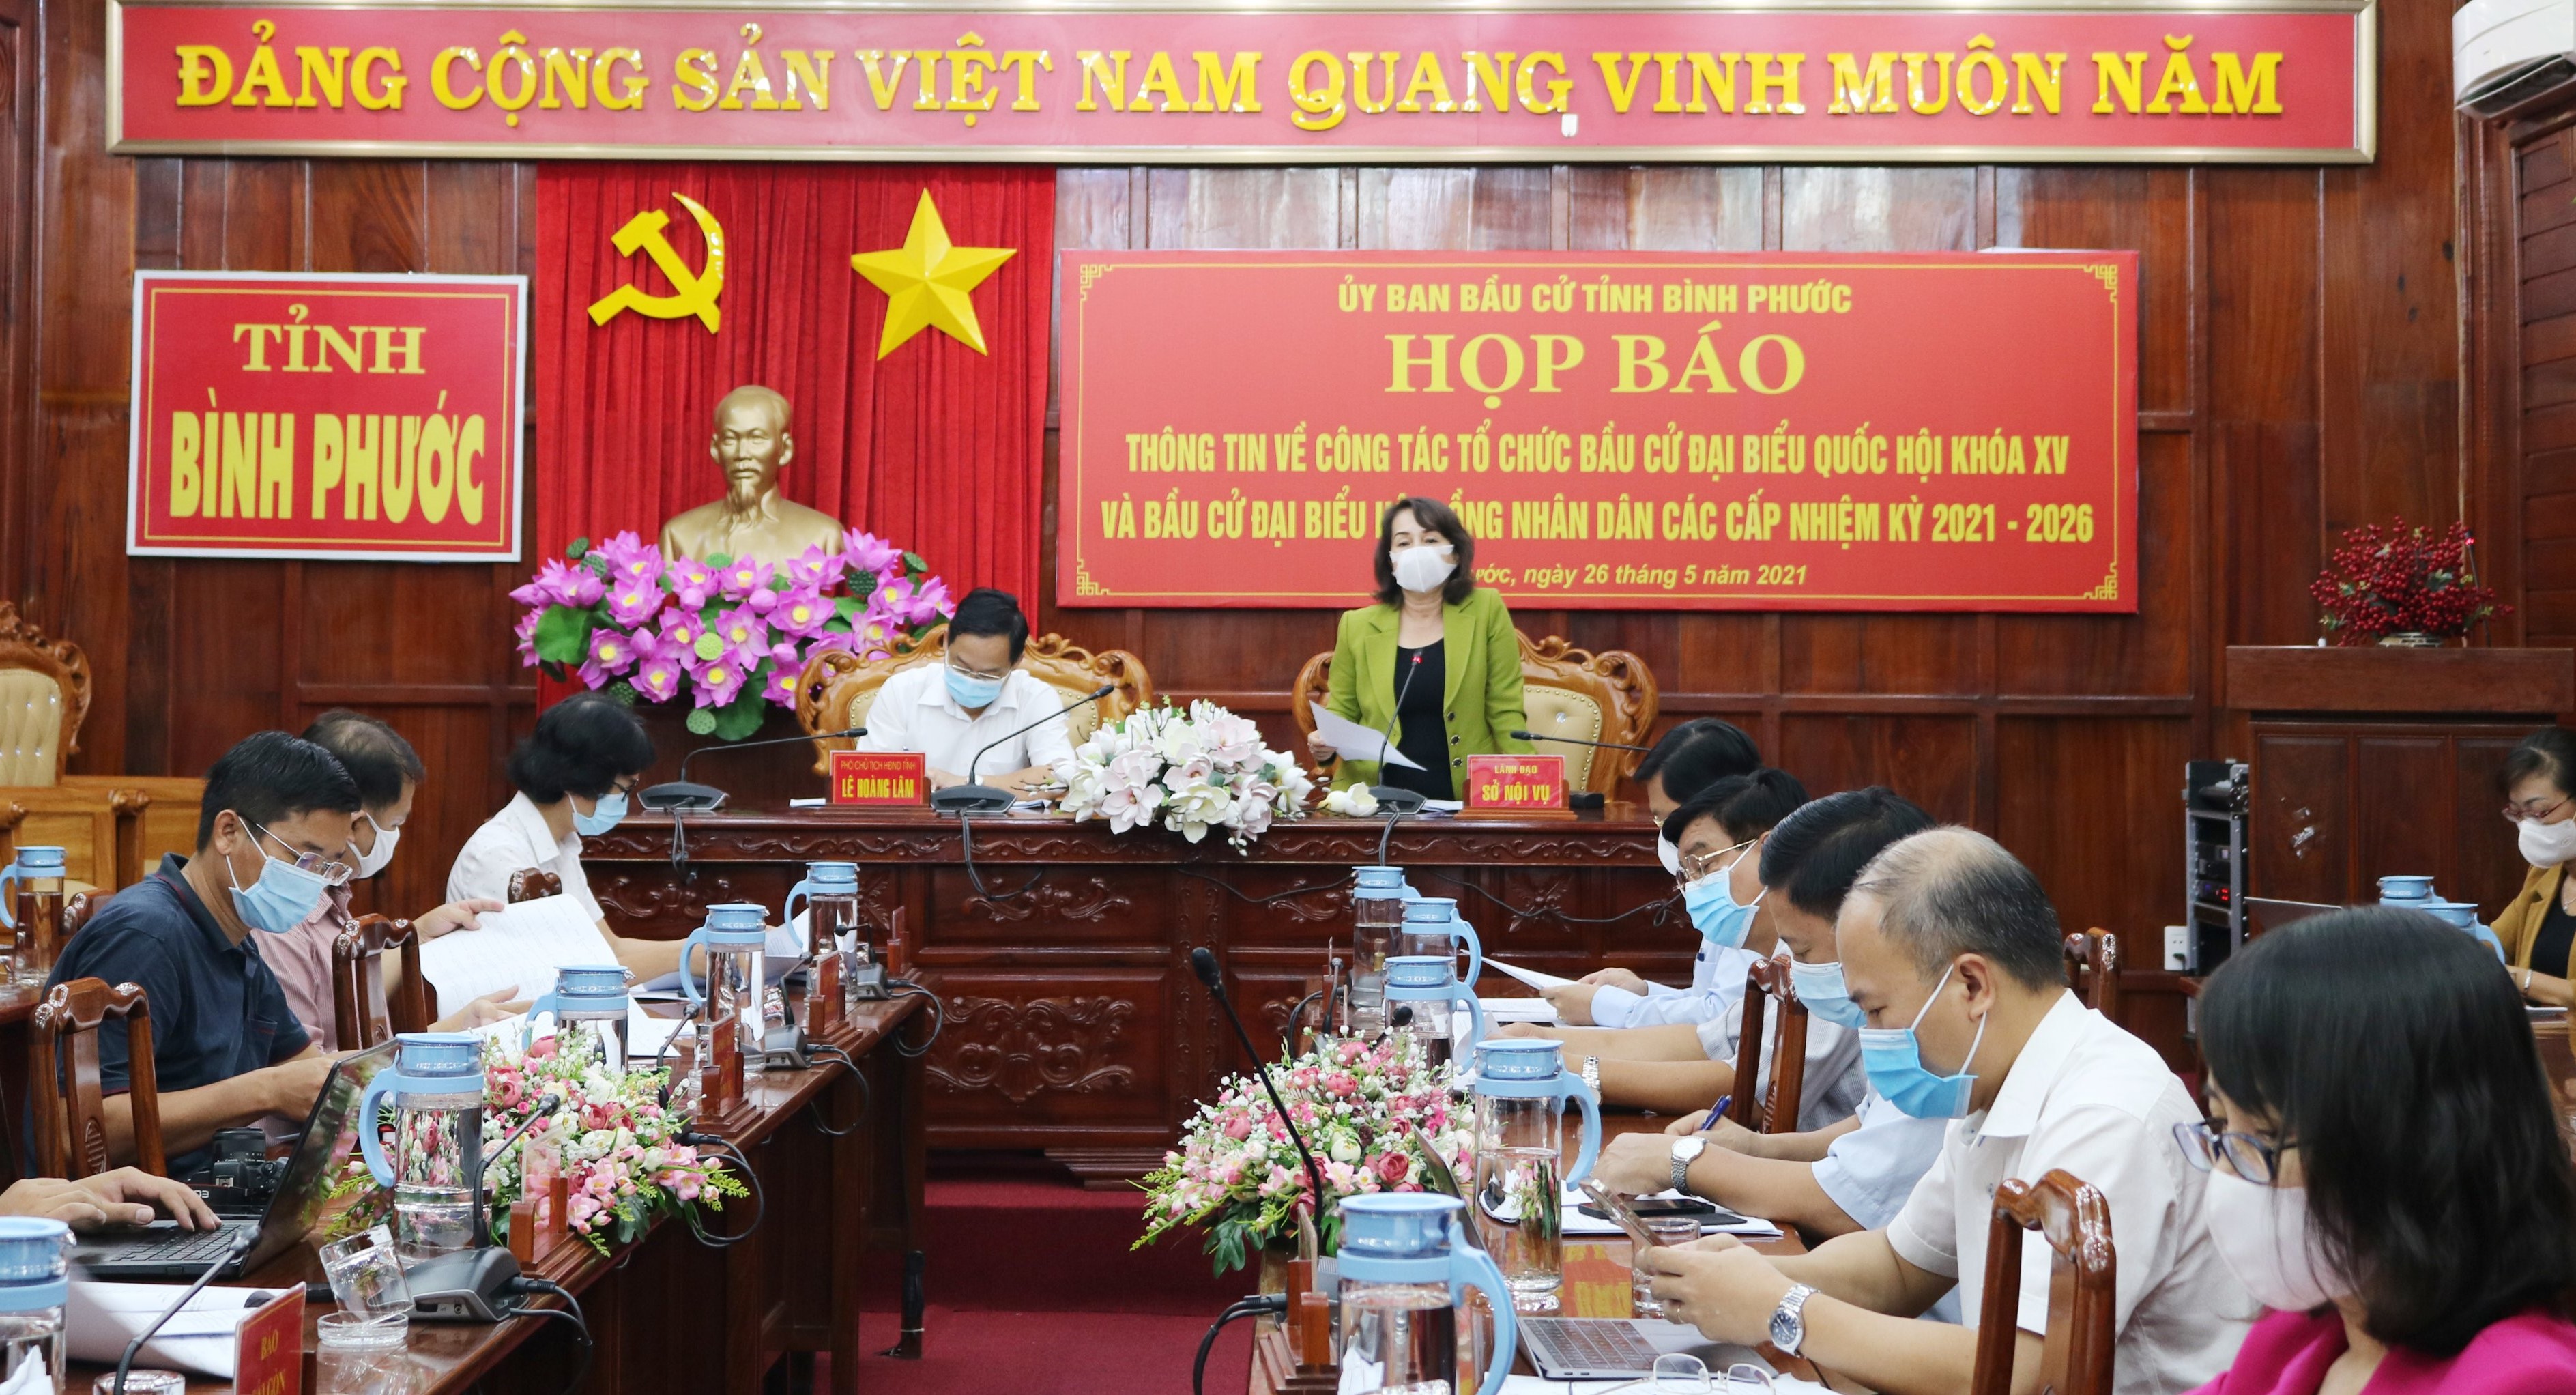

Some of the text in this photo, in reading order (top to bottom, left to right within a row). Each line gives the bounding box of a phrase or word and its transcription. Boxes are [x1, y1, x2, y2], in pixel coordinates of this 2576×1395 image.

[176, 19, 2283, 131] ĐẢNG CỘNG SẢN VIỆT NAM QUANG VINH MUÔN NĂM
[1338, 274, 1852, 315] ỦY BAN BẦU CỬ TỈNH BÌNH PHƯỚC
[234, 304, 427, 375] TỈNH
[1385, 320, 1806, 409] HỌP BÁO
[170, 388, 486, 525] BÌNH PHƯỚC
[1125, 418, 2070, 484] THÔNG TIN VỀ CÔNG TÁC TỔ CHỨC BẦU CỬ ĐẠI BIỂU QUỐC HỘI KHÓA XV
[1101, 493, 1137, 539] VÀ
[1144, 487, 1200, 540] BẦU
[1206, 487, 1247, 540] CỬ
[1251, 500, 1297, 548] ĐẠI
[1305, 485, 1368, 540] BIỂU
[1447, 488, 1504, 541] ỒNG
[1511, 493, 1589, 541] NHÂN
[1597, 493, 1655, 541] DÂN
[1662, 493, 1718, 541] CÁC
[1726, 488, 1782, 541] CẤP
[1789, 495, 1881, 549] NHIỆM
[1889, 495, 1922, 542] KỲ
[1932, 503, 1996, 543] 2021
[2008, 521, 2019, 531] -
[2027, 504, 2094, 543] 2026
[1524, 564, 1579, 588] ngày
[1584, 564, 1610, 585] 26
[1615, 564, 1679, 588] tháng
[1684, 564, 1698, 586] 5
[1703, 566, 1750, 586] năm
[1757, 564, 1808, 586] 2021
[854, 758, 868, 770] CHỦ
[1494, 764, 1538, 776] LÃNH ĐẠO
[842, 775, 915, 799] LÊ HOÀNG LÂM
[1482, 779, 1550, 805] SỞ NỘI VỤ
[261, 1325, 279, 1360] BÁO
